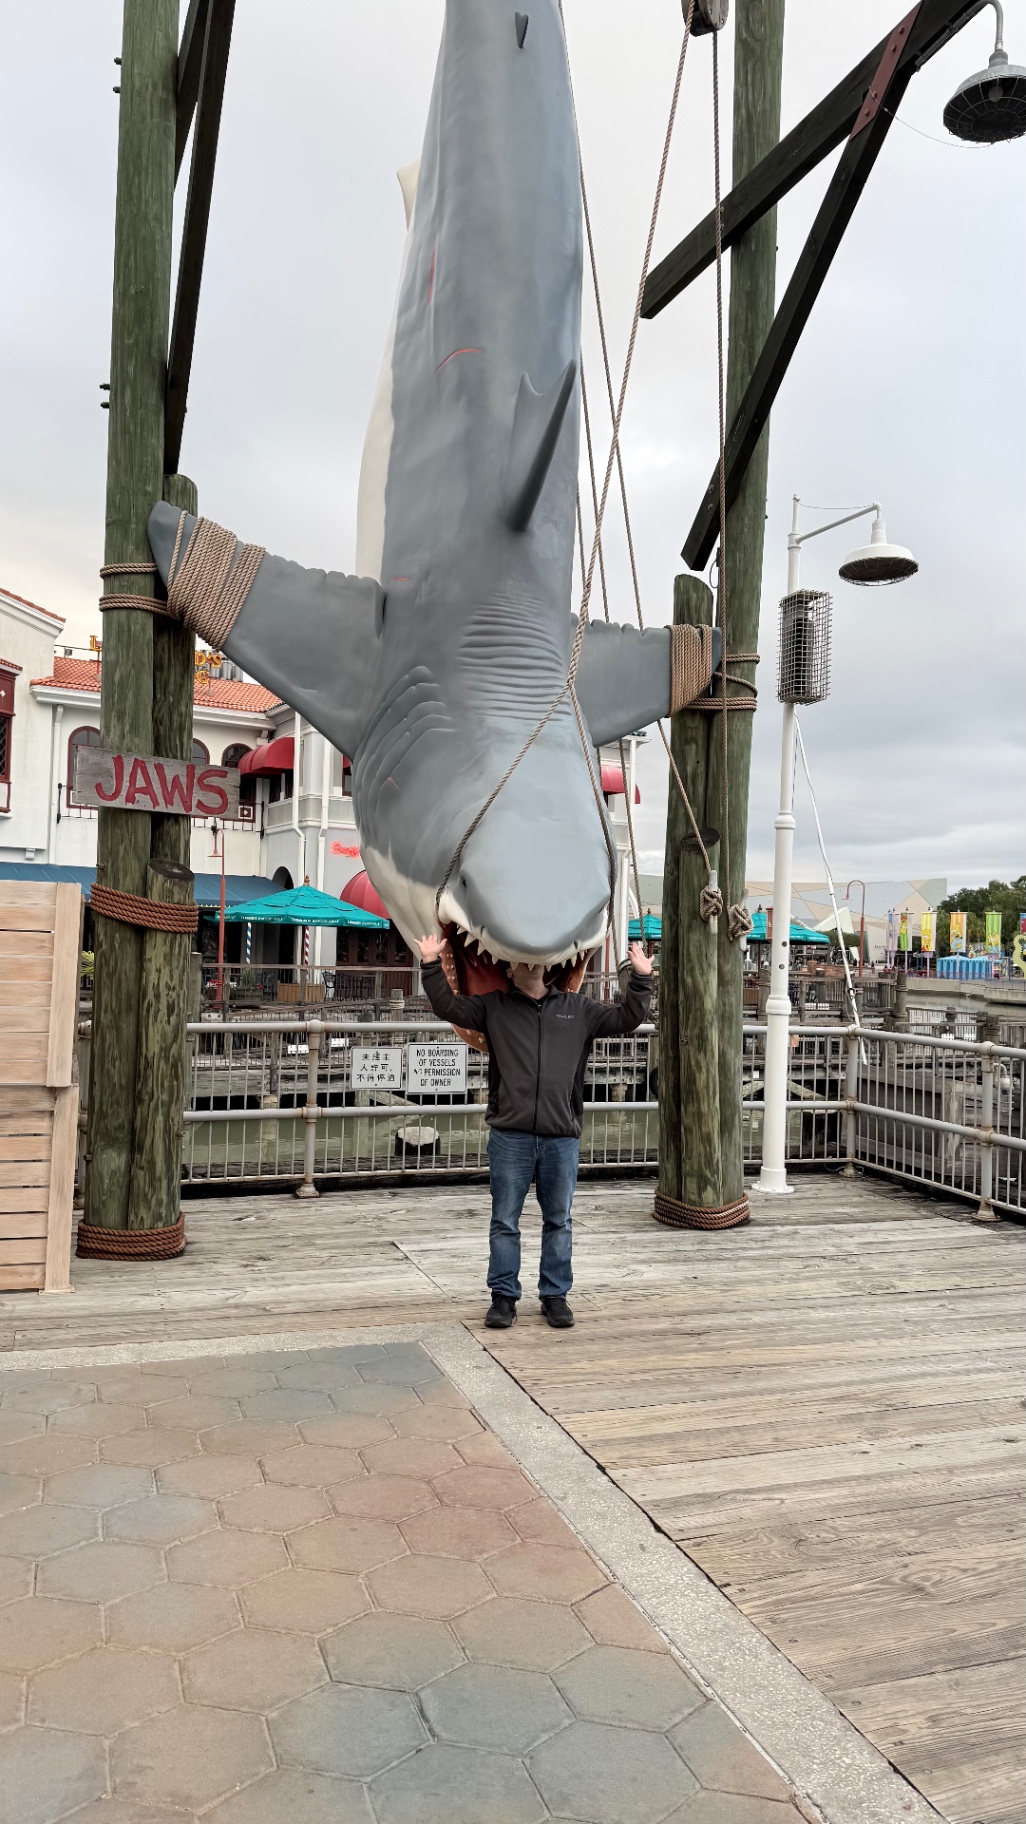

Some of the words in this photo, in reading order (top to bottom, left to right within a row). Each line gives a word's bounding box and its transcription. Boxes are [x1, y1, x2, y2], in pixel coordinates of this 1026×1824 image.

[95, 754, 229, 815] JAWS
[416, 1048, 426, 1057] NO
[427, 1048, 459, 1057] BOARDING
[418, 1058, 427, 1067] OF
[428, 1058, 456, 1067] VESSELS
[424, 1068, 461, 1077] PERMISSION
[420, 1078, 428, 1087] OF
[430, 1078, 452, 1087] OWNER
